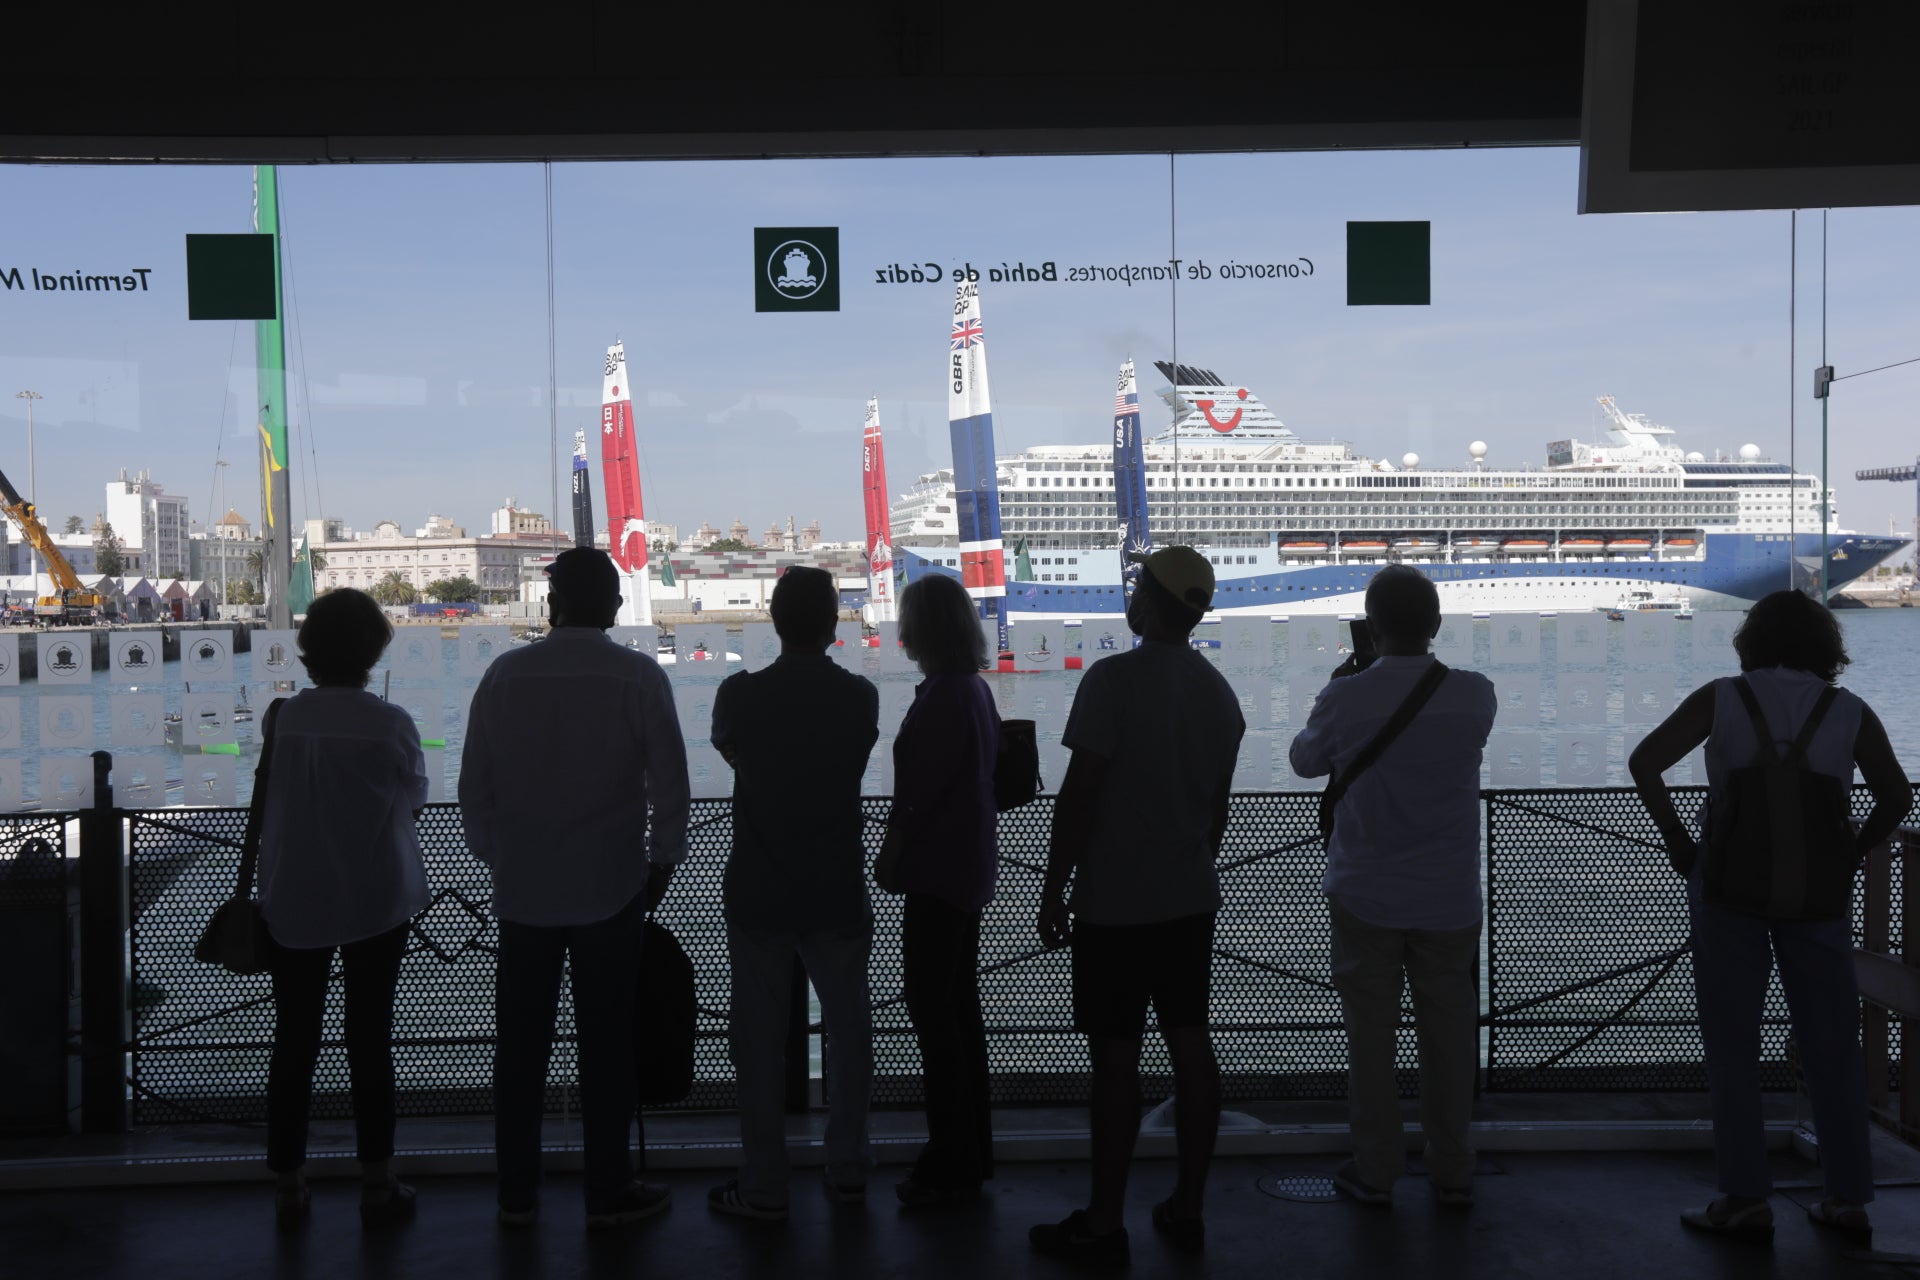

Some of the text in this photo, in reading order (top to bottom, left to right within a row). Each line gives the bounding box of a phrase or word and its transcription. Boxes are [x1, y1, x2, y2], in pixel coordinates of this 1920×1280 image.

[955, 301, 970, 316] GP
[953, 354, 963, 394] GBR
[604, 407, 614, 435] 日本
[1116, 418, 1124, 448] USA
